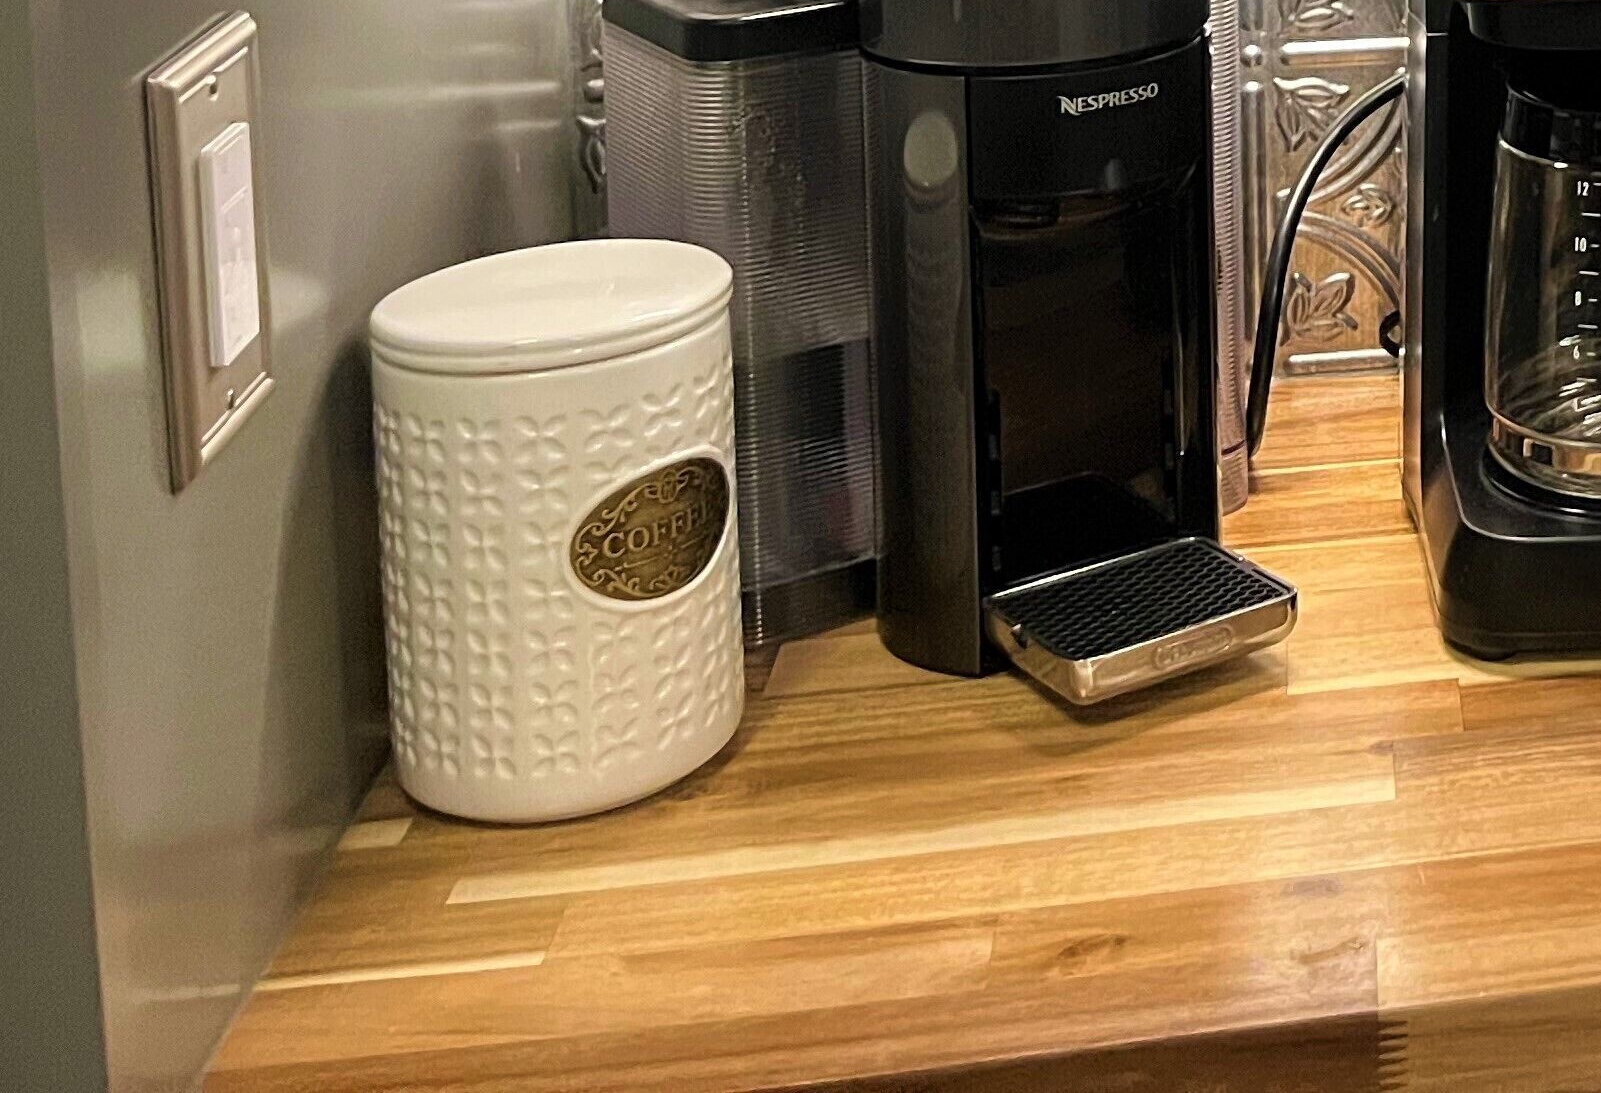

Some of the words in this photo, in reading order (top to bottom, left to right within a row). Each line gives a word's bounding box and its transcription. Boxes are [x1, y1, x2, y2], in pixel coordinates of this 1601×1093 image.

[1056, 82, 1159, 116] NESPRESSO
[1577, 180, 1589, 196] 12
[1574, 236, 1587, 252] 10
[1572, 345, 1580, 359] 6
